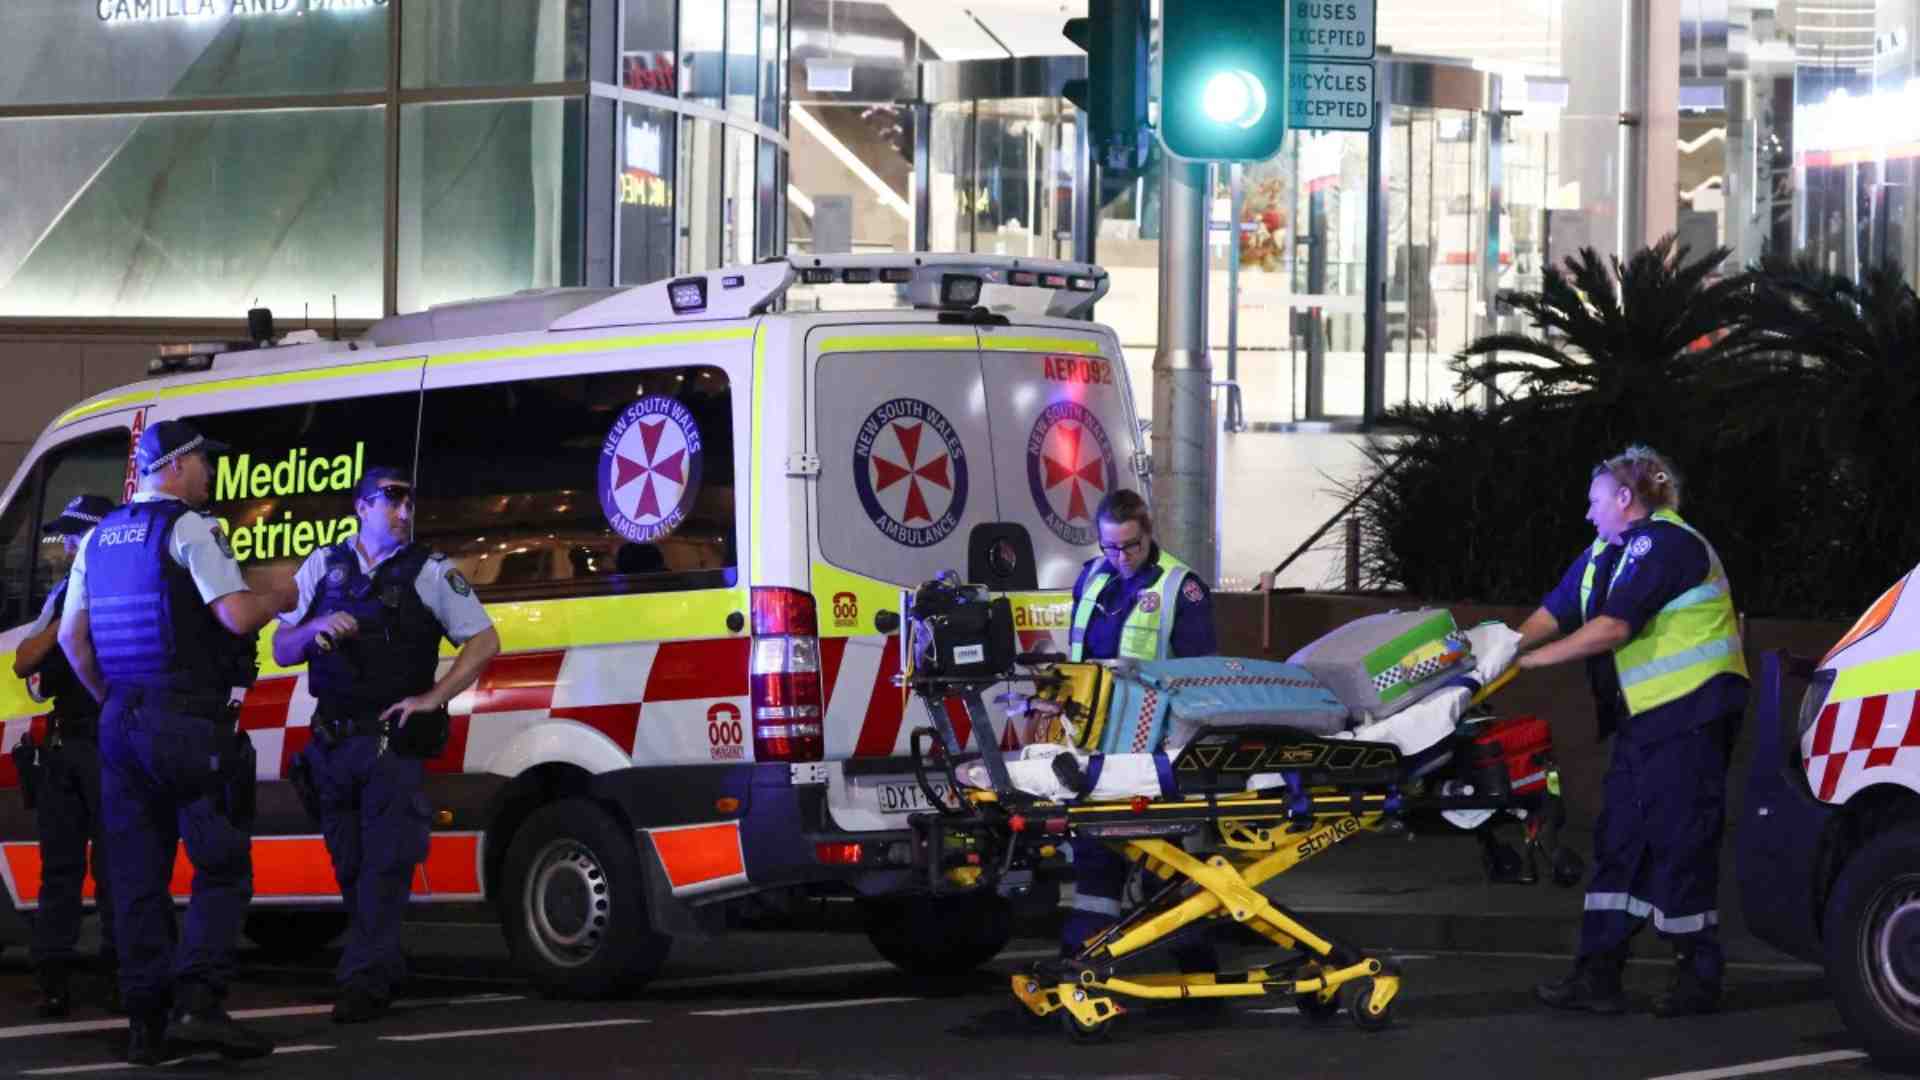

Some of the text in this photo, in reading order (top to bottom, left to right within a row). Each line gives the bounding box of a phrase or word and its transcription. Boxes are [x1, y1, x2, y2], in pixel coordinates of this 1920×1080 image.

[1298, 3, 1357, 20] BUSES
[603, 398, 701, 457] NEW SOUTH WALES
[856, 400, 964, 460] NEW SOUTH WALES
[1029, 421, 1049, 456] NEW
[215, 441, 365, 501] Medical
[99, 529, 147, 546] POLICE
[217, 511, 359, 561] etrieva
[610, 507, 685, 541] AMBULANCE
[876, 513, 957, 545] AMBULANCE
[833, 603, 857, 619] 000
[709, 721, 743, 745] 000
